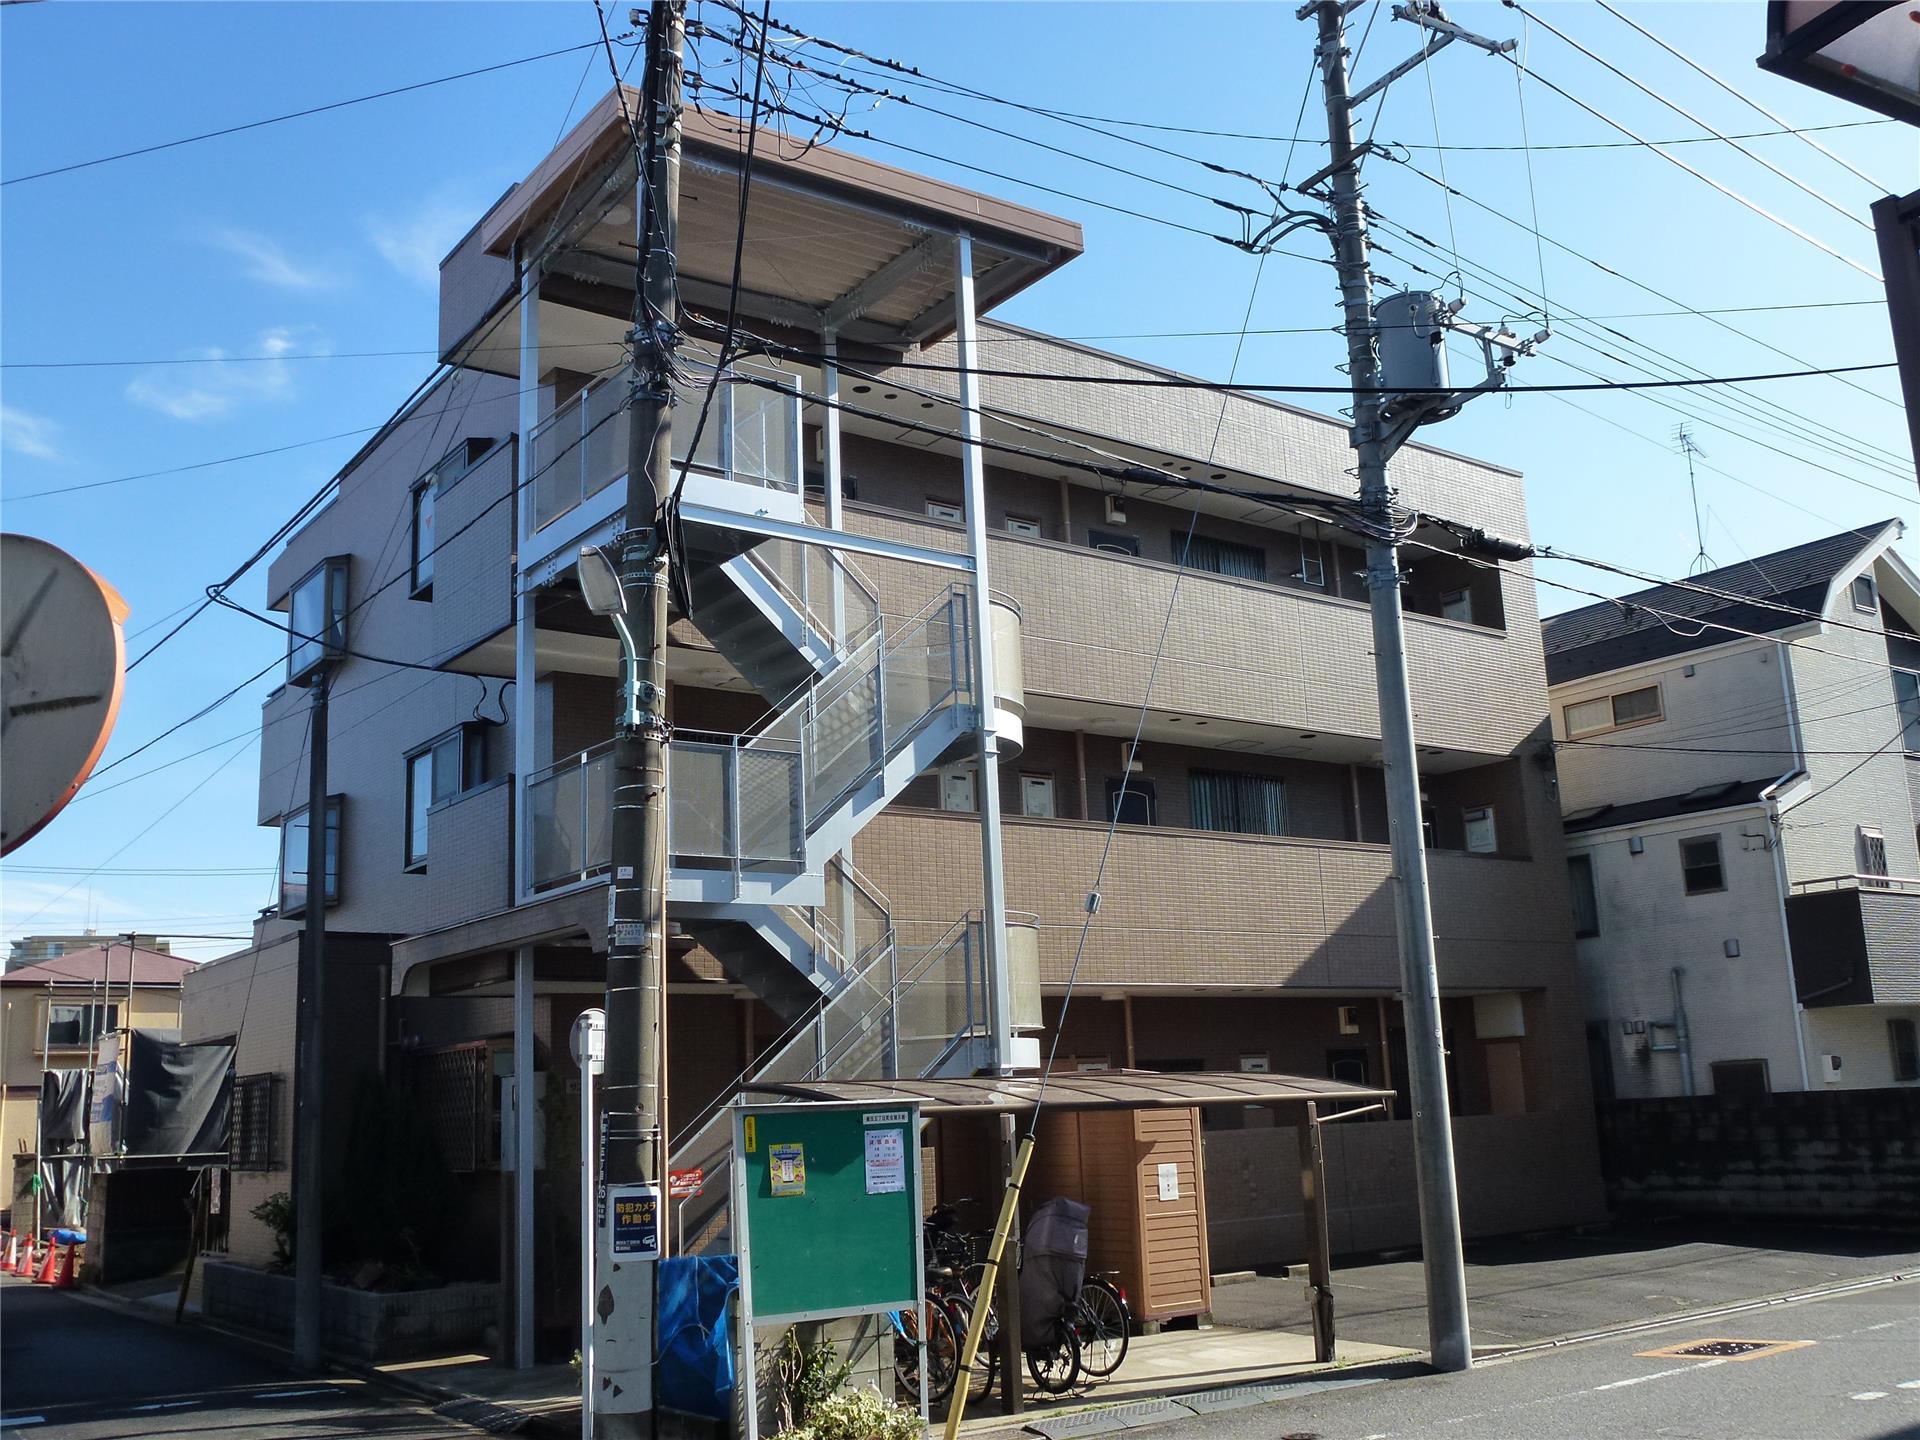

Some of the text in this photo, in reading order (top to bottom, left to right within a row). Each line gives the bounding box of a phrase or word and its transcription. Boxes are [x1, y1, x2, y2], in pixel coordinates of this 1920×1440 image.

[616, 1202, 656, 1213] 防犯カメラ
[622, 1213, 651, 1224] 作動中
